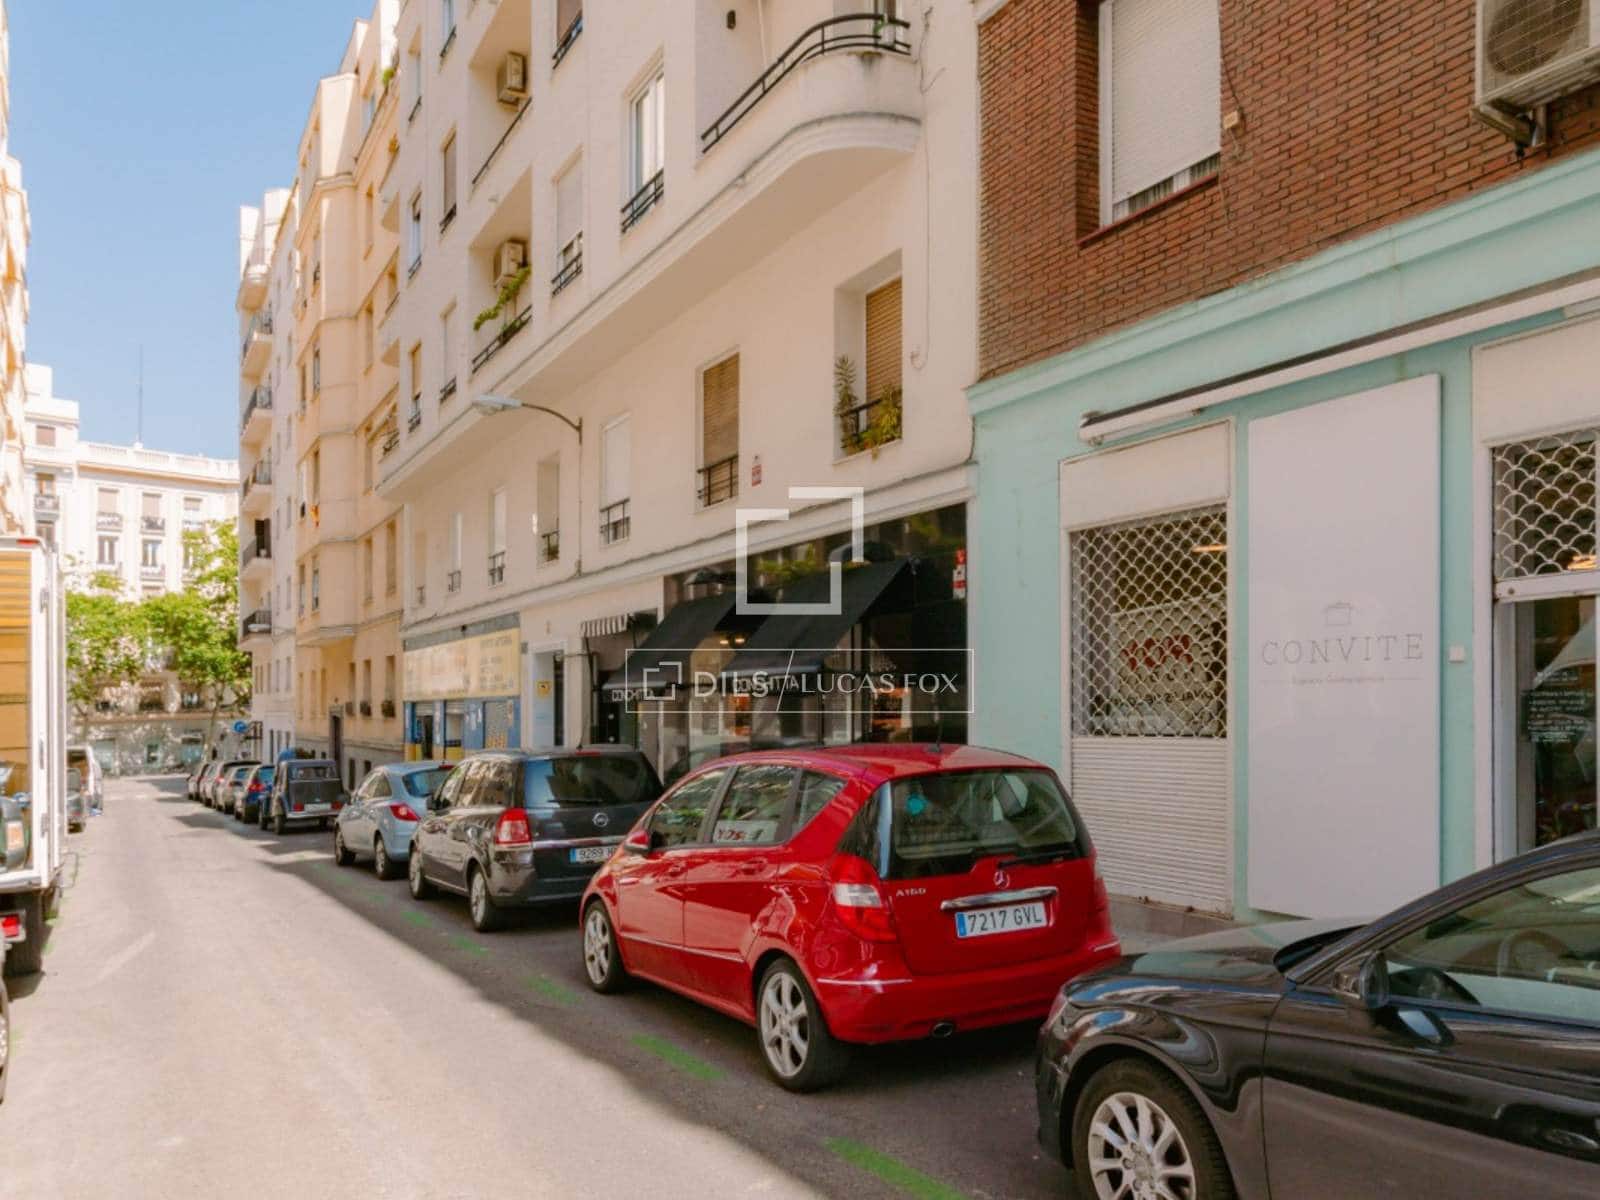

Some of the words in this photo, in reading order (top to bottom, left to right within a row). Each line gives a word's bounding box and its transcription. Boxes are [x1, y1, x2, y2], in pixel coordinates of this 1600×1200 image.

[1262, 633, 1424, 666] CONVITE
[967, 909, 1008, 932] 7217
[1014, 905, 1042, 926] GVL
